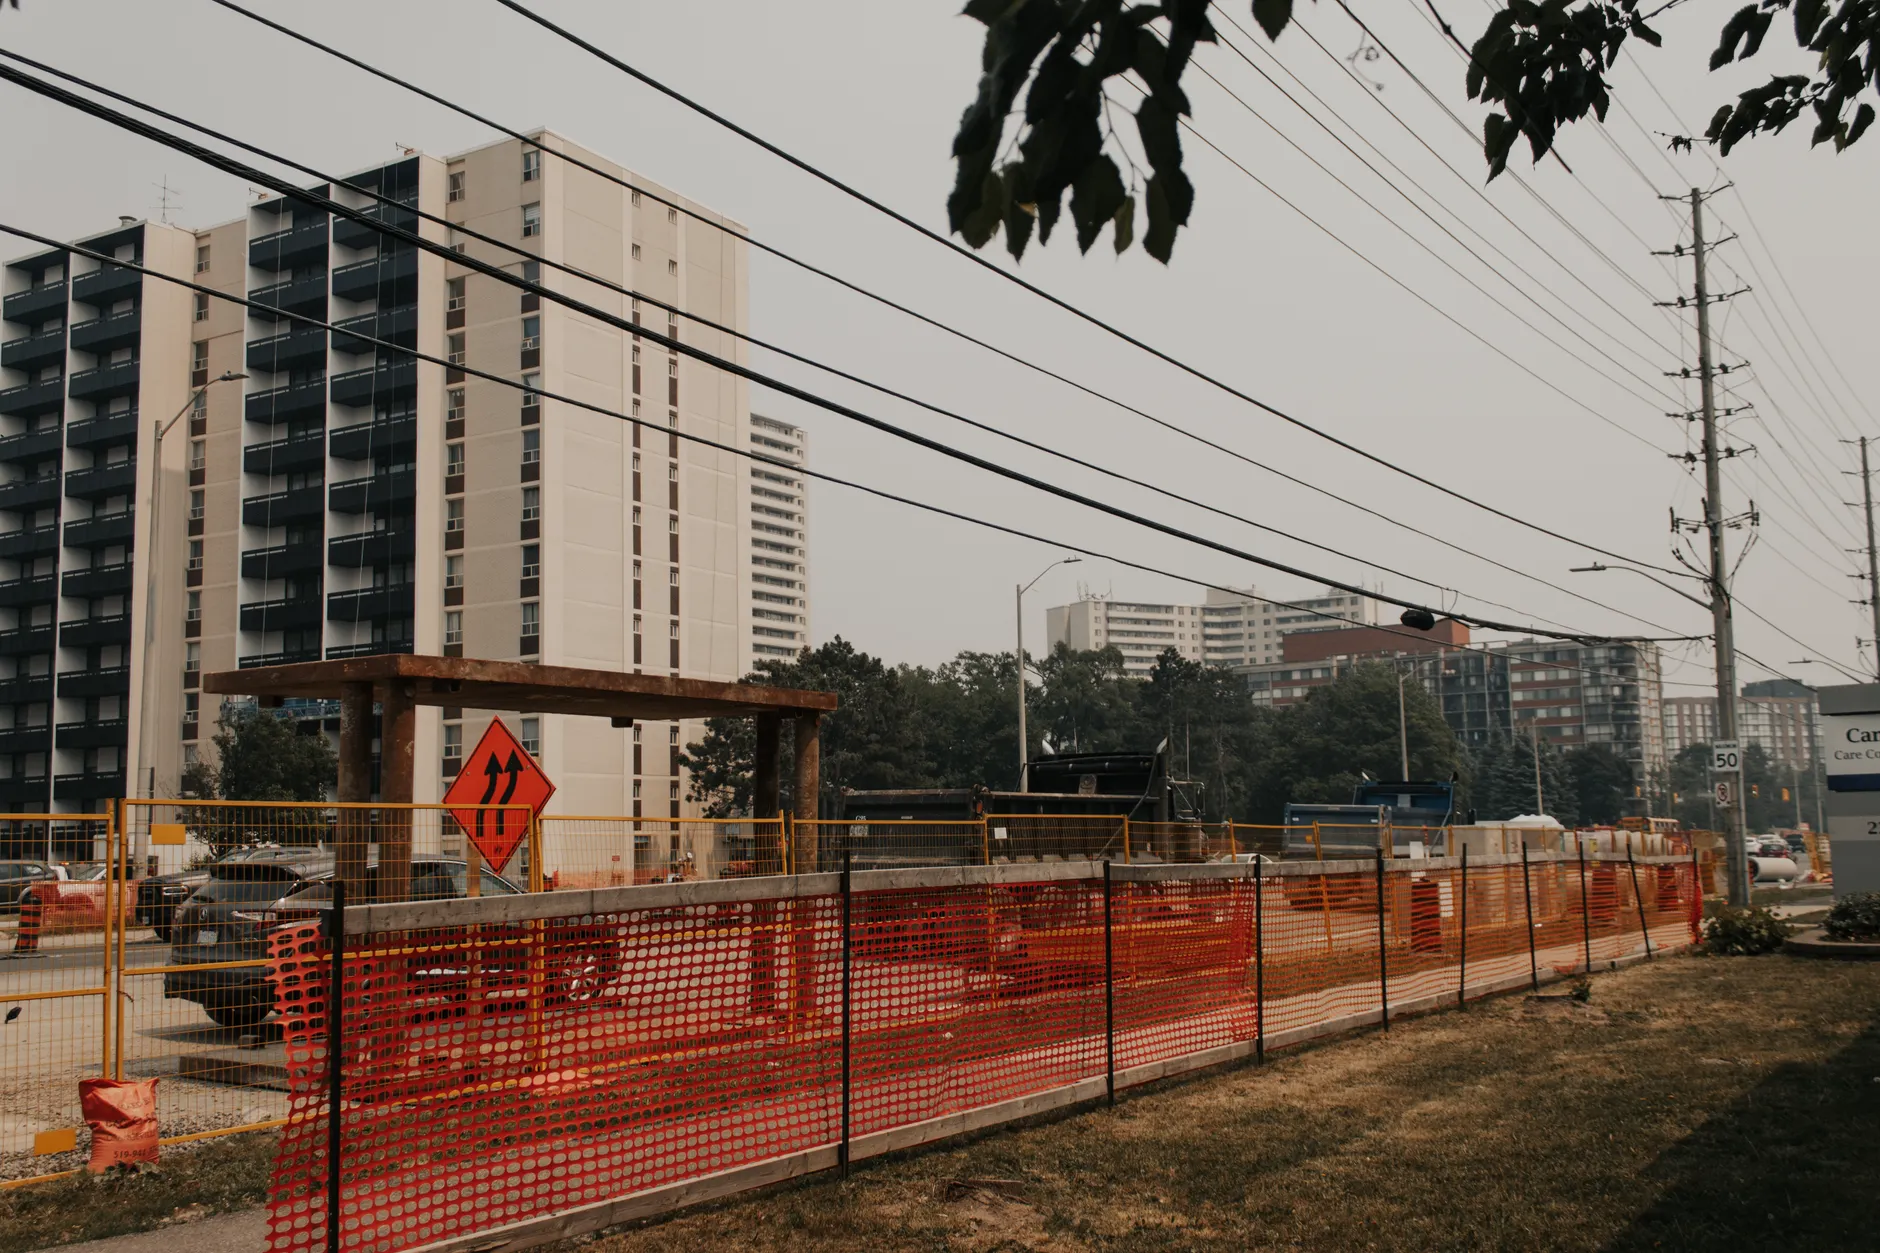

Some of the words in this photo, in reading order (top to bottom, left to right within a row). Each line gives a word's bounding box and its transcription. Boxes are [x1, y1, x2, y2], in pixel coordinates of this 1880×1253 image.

[1716, 752, 1738, 768] 50
[1834, 749, 1862, 760] Care
[1867, 821, 1880, 835] 2
